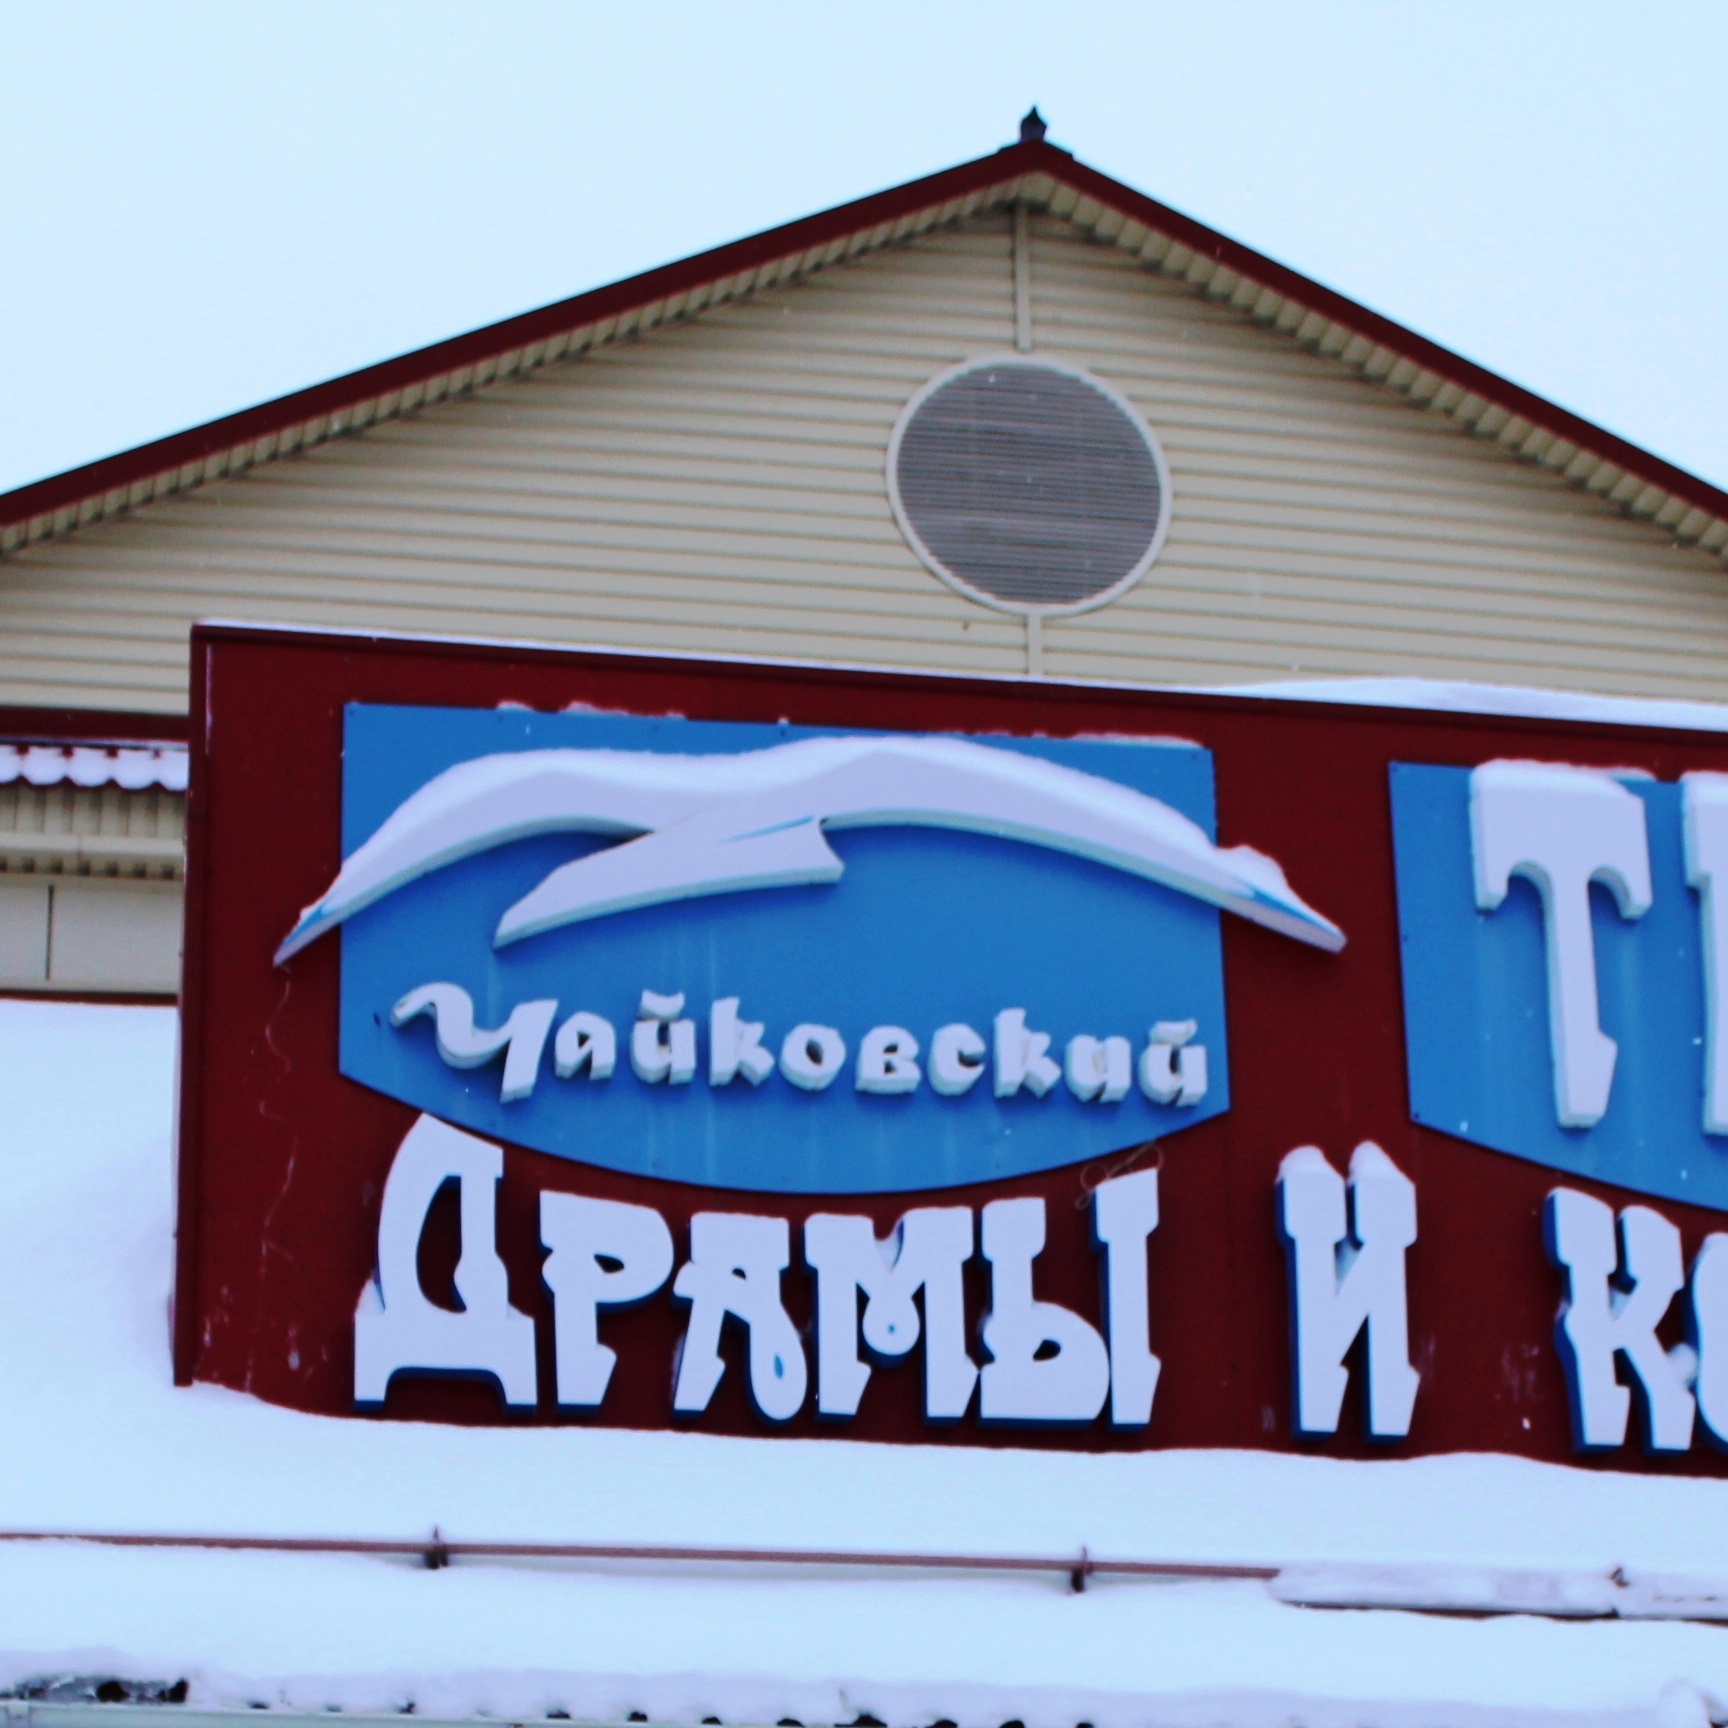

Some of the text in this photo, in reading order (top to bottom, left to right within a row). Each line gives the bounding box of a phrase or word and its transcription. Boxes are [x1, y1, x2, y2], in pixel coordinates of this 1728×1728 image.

[391, 982, 1209, 1103] Чайковский
[352, 1113, 1163, 1425] ДРАМЫ
[1277, 1141, 1421, 1440] И
